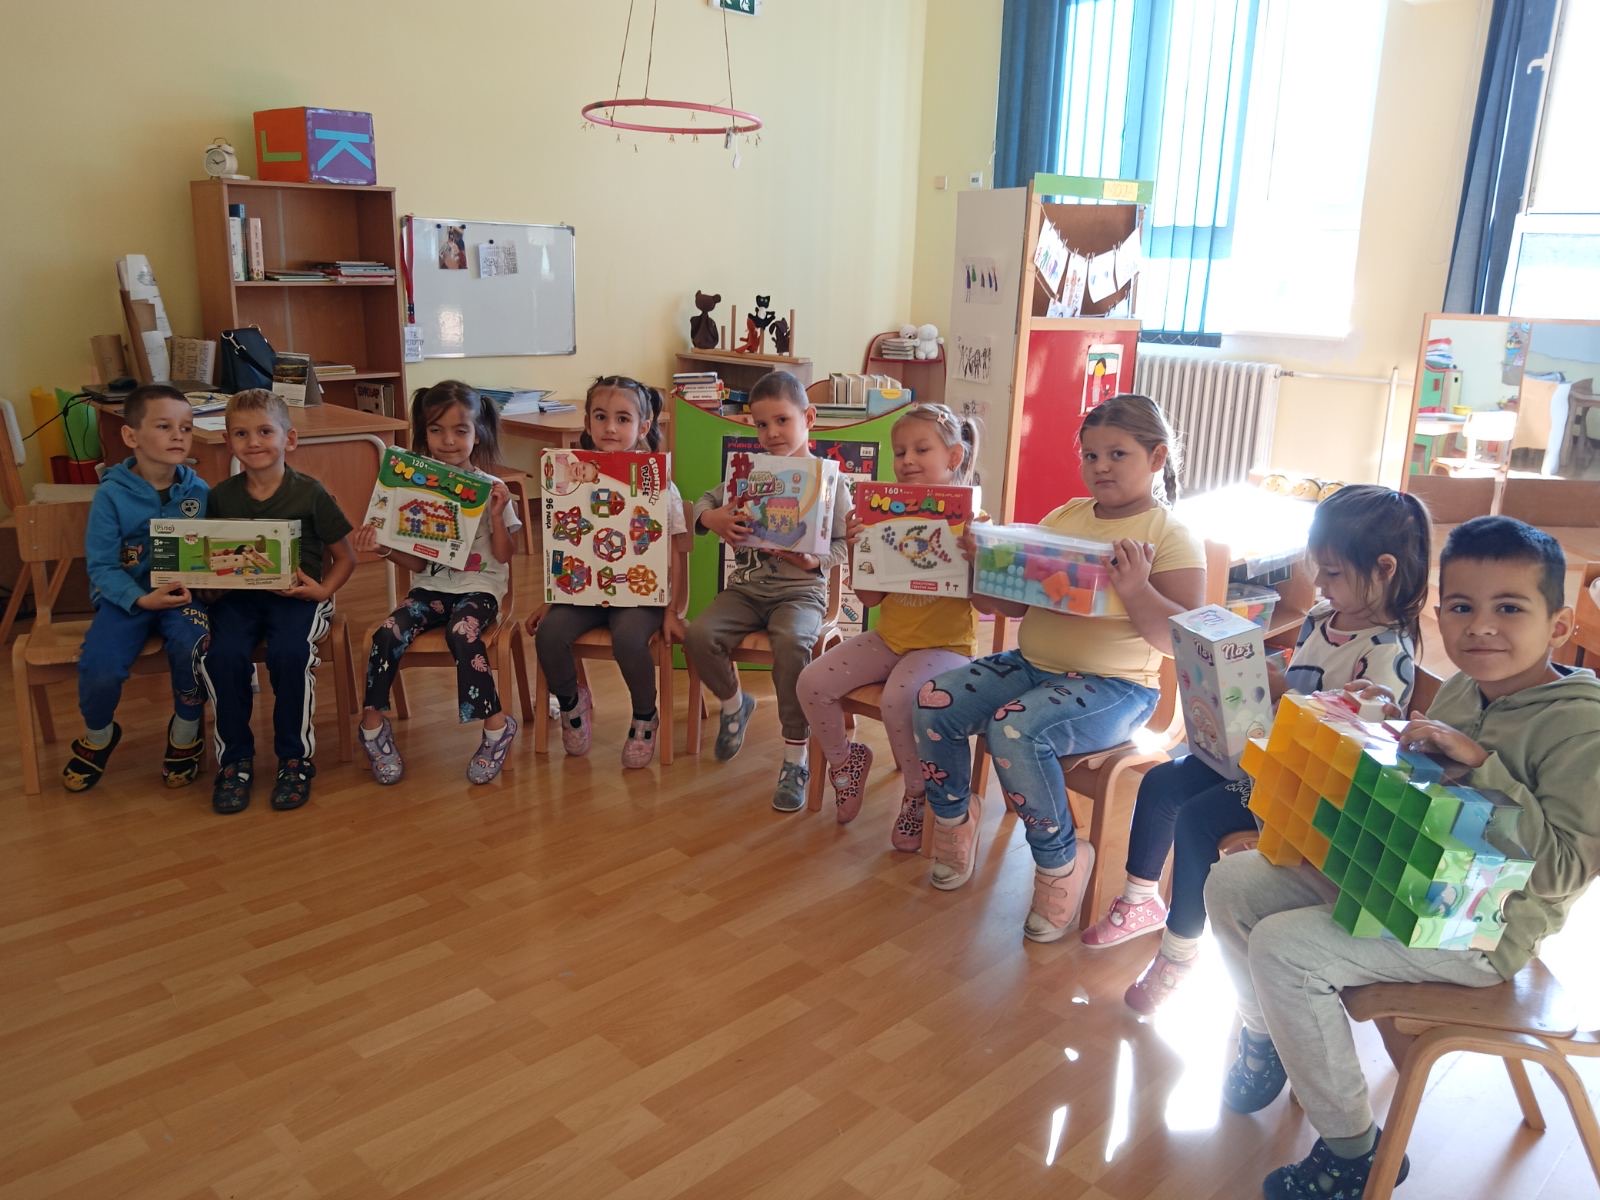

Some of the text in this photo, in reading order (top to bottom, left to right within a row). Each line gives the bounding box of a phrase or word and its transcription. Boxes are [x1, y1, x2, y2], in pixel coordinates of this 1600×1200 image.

[412, 459, 424, 468] 120
[394, 461, 478, 502] MOZAIK
[641, 464, 650, 497] PUZZLE
[648, 457, 660, 506] GEOMETRIK
[884, 487, 899, 495] 160
[545, 498, 554, 510] 96
[870, 493, 963, 519] MOZAIK
[183, 607, 209, 621] SPID
